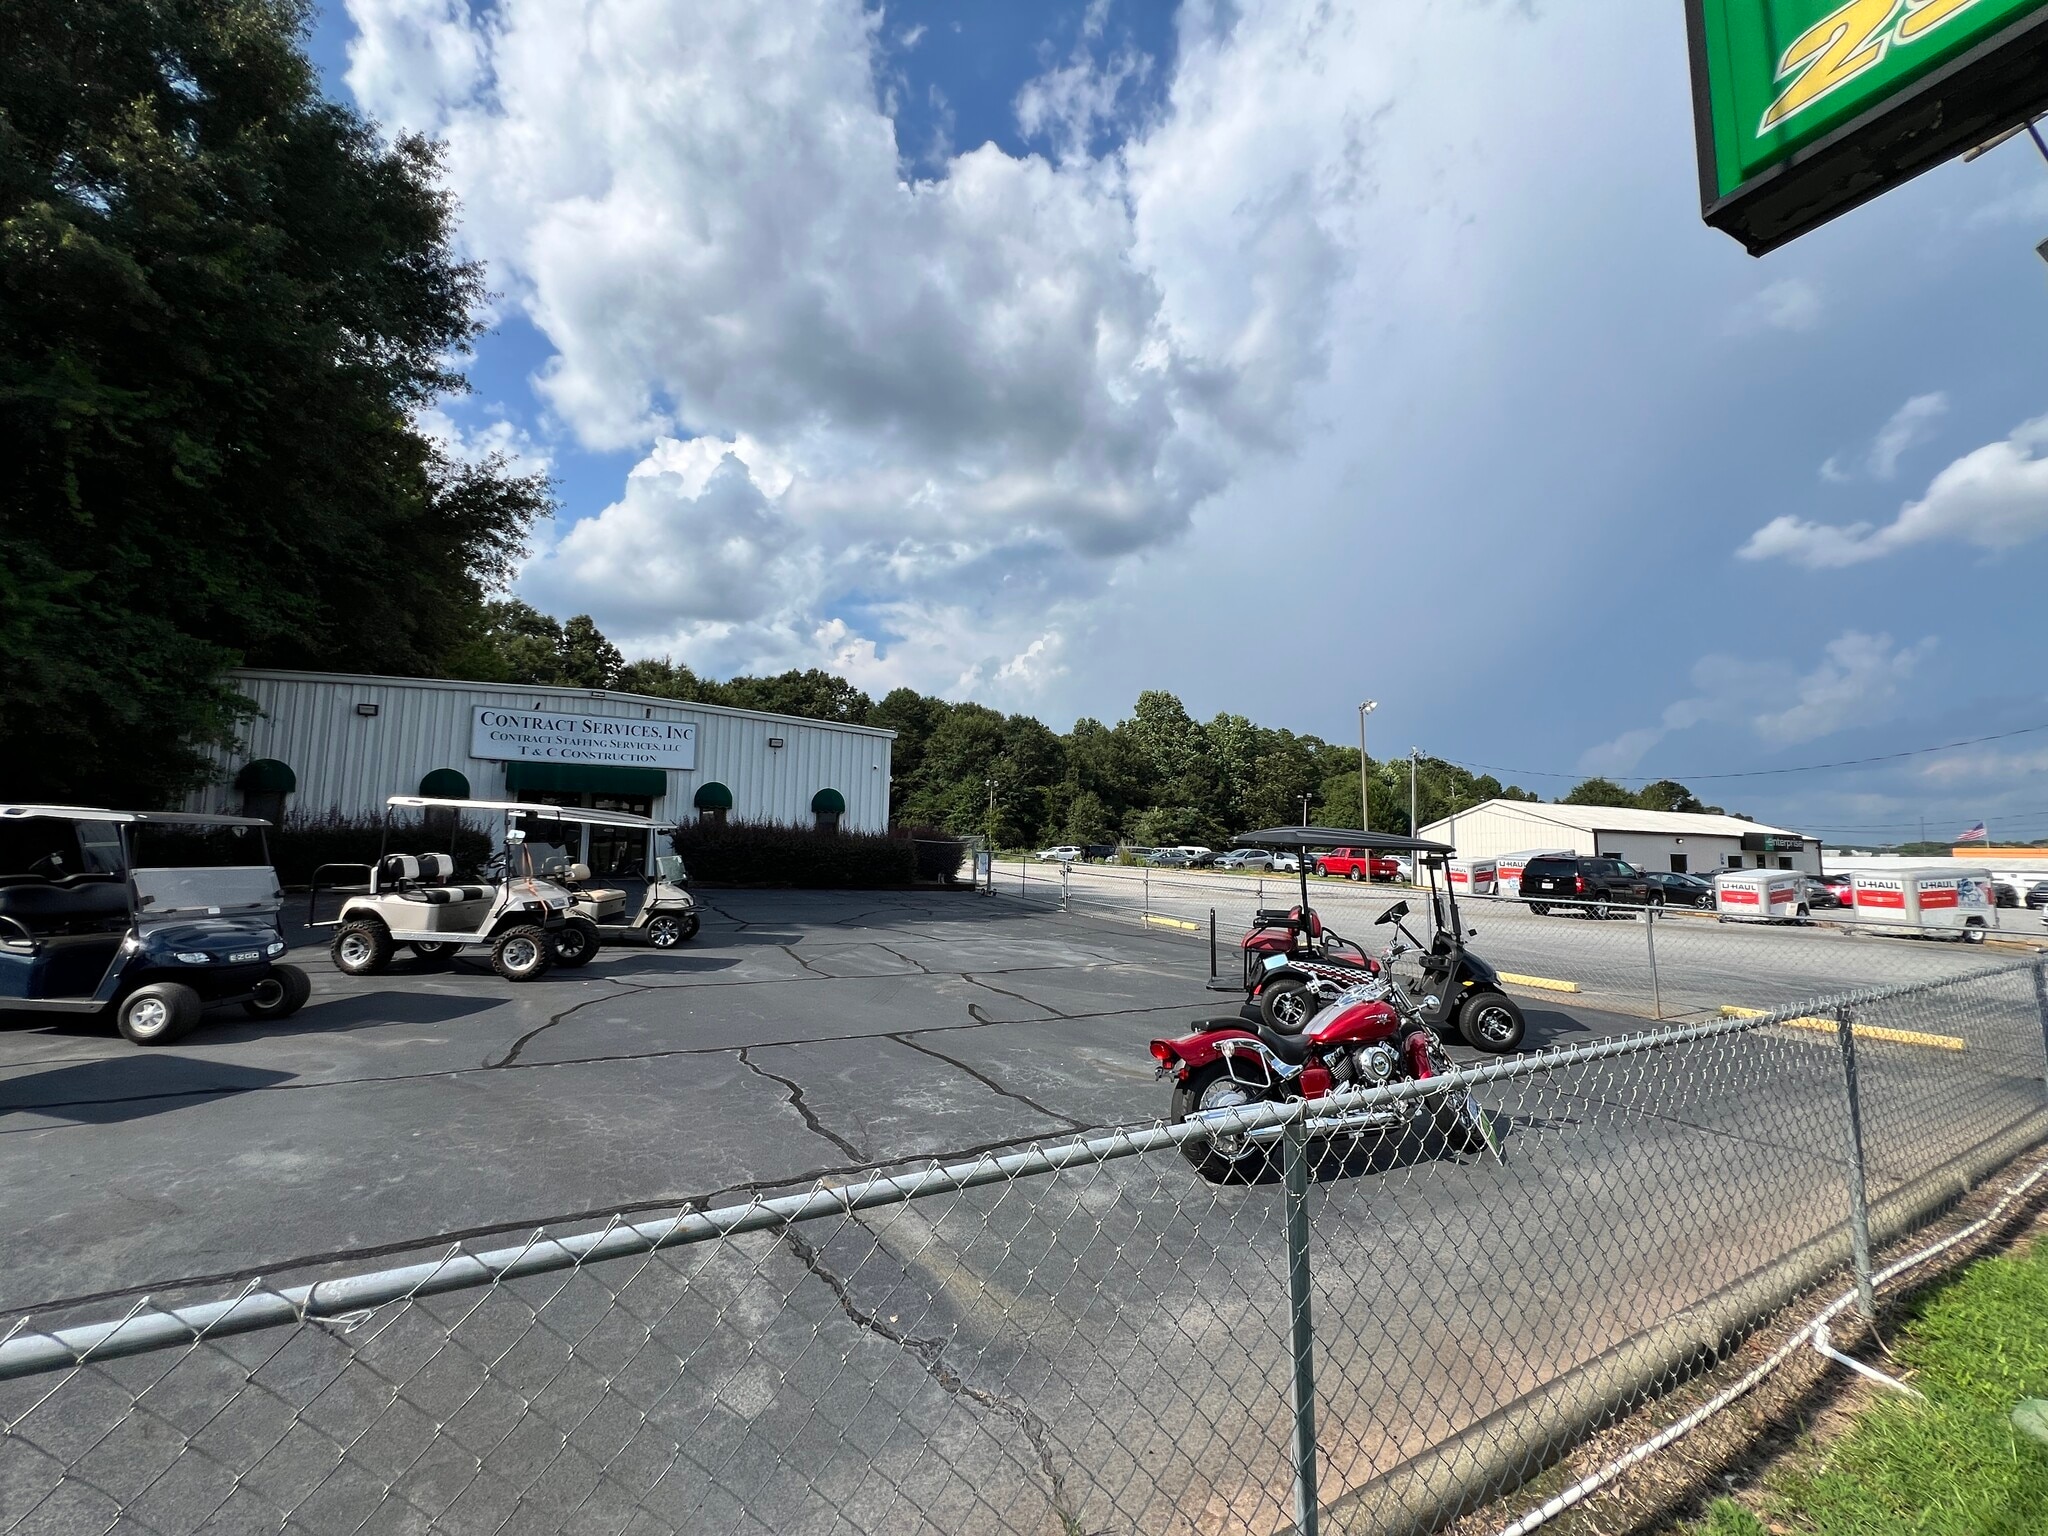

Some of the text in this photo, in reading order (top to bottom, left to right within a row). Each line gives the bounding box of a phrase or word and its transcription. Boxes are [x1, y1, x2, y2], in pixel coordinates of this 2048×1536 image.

[480, 711, 694, 740] CONTRACT SERVICES, INC
[490, 731, 553, 744] CONTRACT
[555, 735, 607, 748] STAFFING
[663, 744, 682, 752] LLC
[519, 746, 529, 755] T
[546, 747, 558, 757] C
[561, 749, 657, 762] CONSTRUCTION
[1857, 880, 1901, 890] U-HAUL
